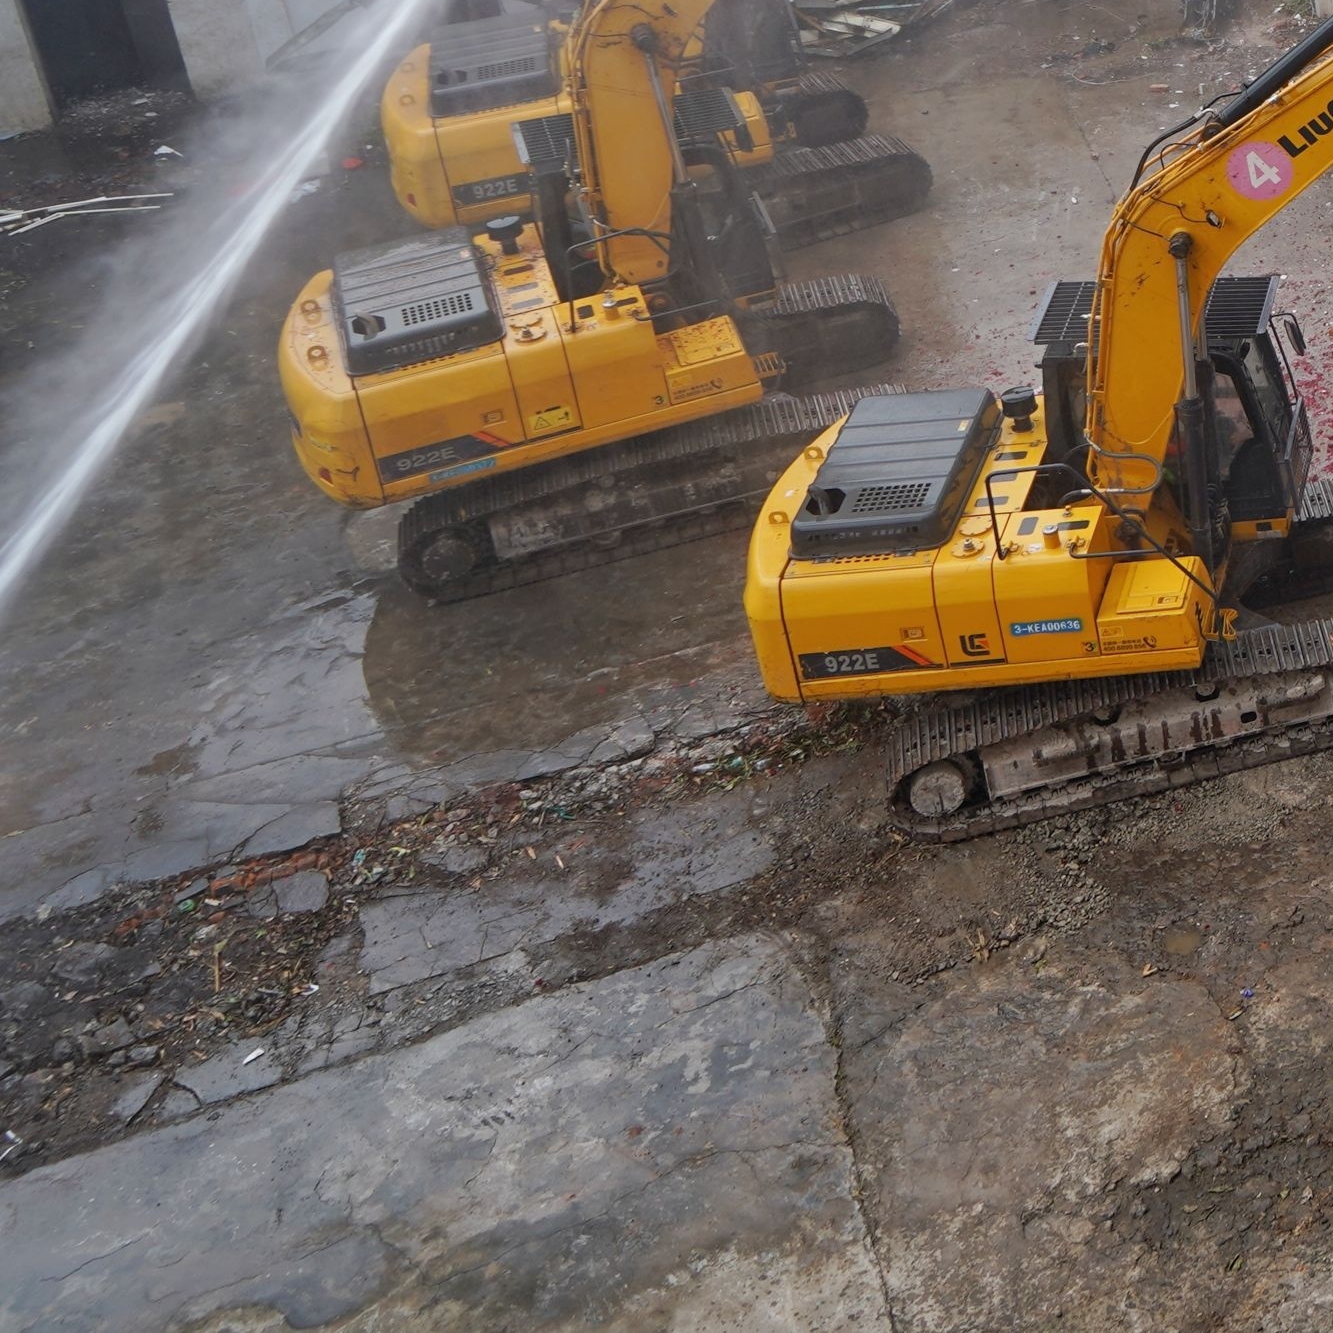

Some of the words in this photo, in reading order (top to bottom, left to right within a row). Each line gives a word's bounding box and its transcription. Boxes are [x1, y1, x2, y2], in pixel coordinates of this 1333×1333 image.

[1245, 150, 1282, 189] 4
[472, 178, 518, 199] 922E
[396, 446, 456, 471] 922E
[1013, 619, 1081, 634] 3-KEA00636
[824, 652, 880, 674] 922E
